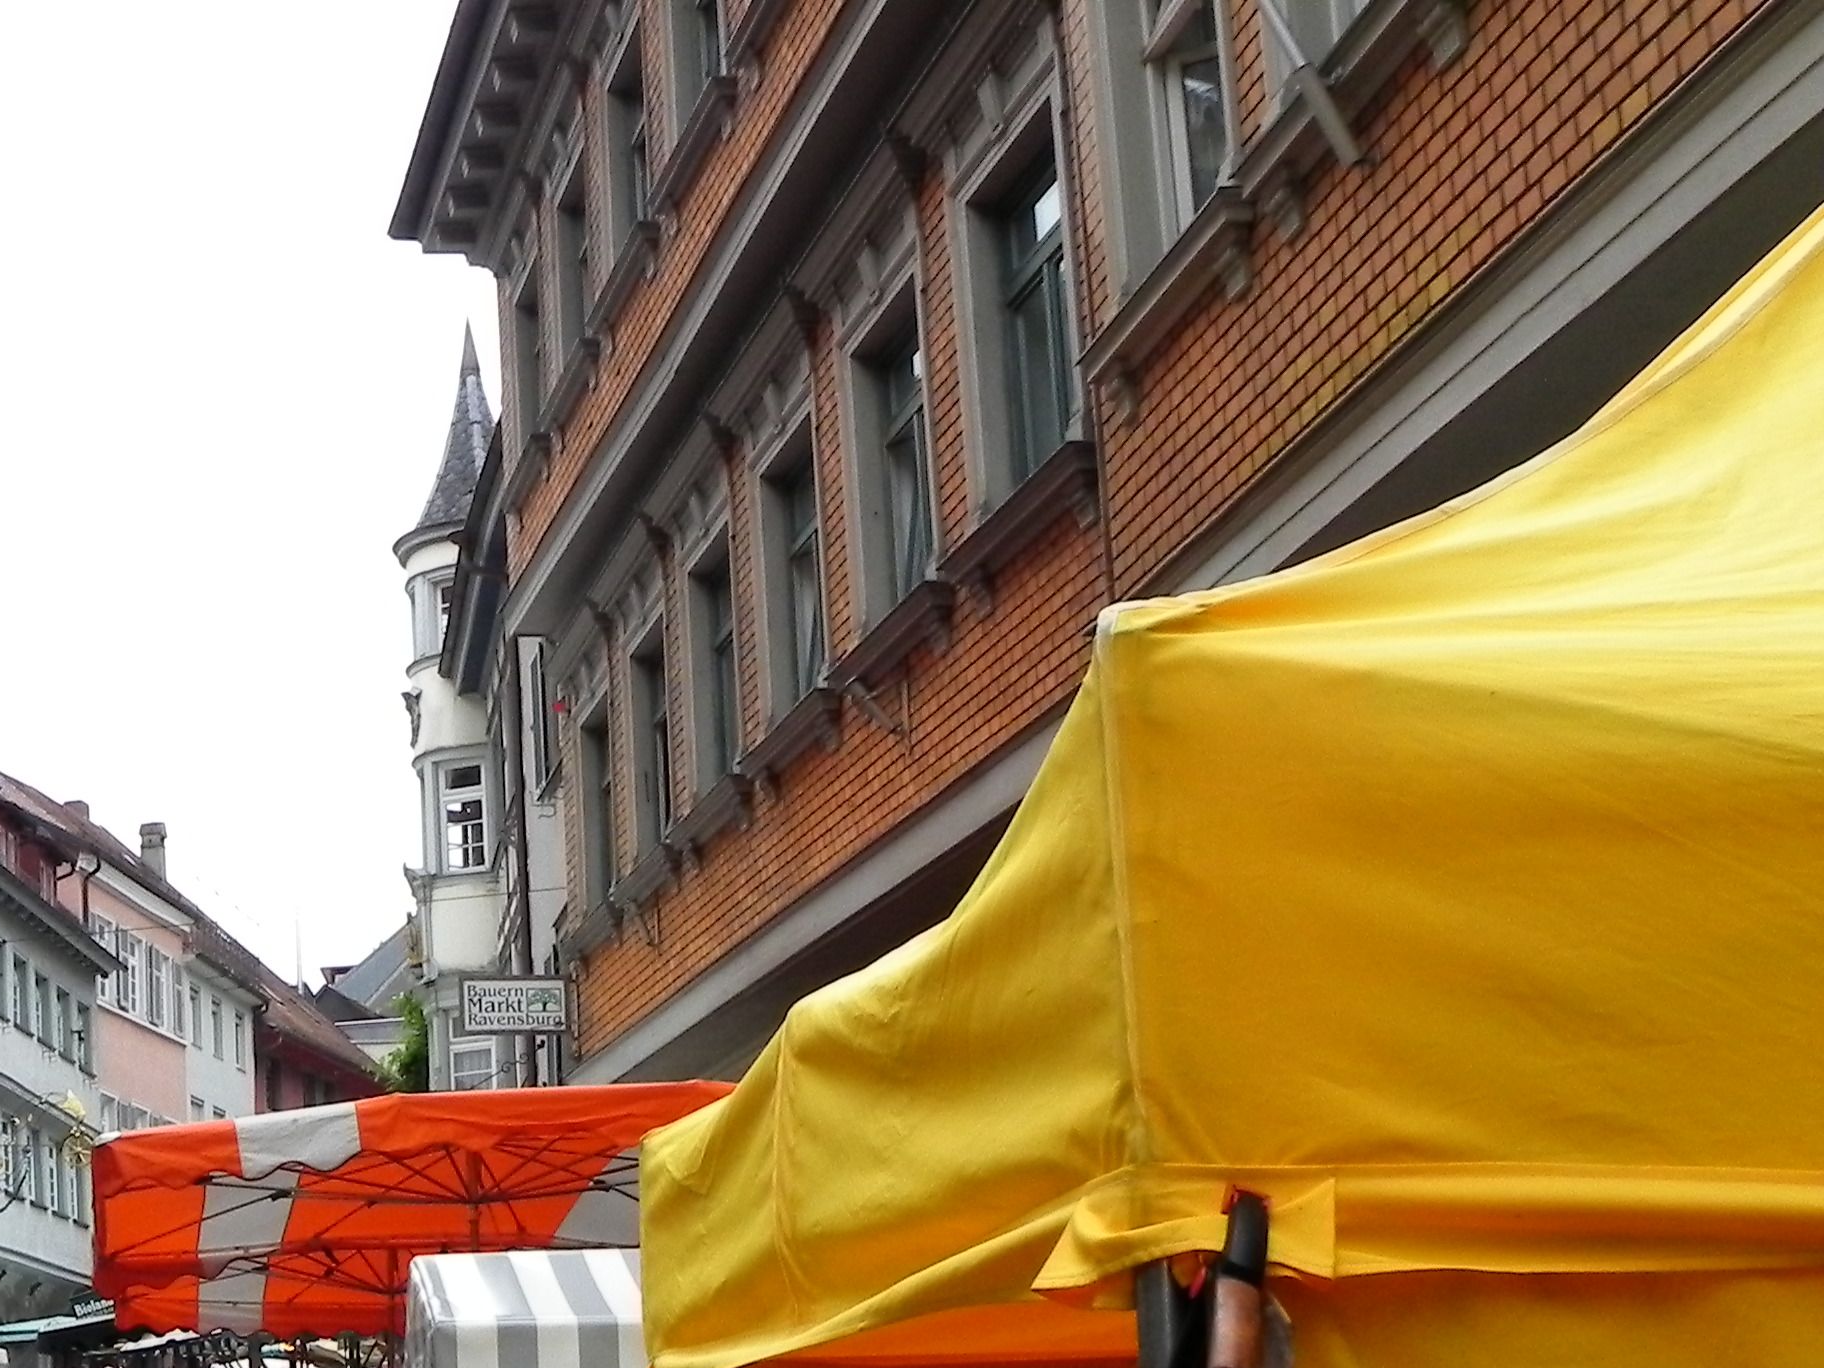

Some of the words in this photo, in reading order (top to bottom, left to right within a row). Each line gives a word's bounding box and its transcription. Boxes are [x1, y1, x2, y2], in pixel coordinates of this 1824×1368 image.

[467, 984, 524, 998] Bauern
[468, 998, 525, 1014] Markt
[468, 1013, 564, 1028] Ravensburg
